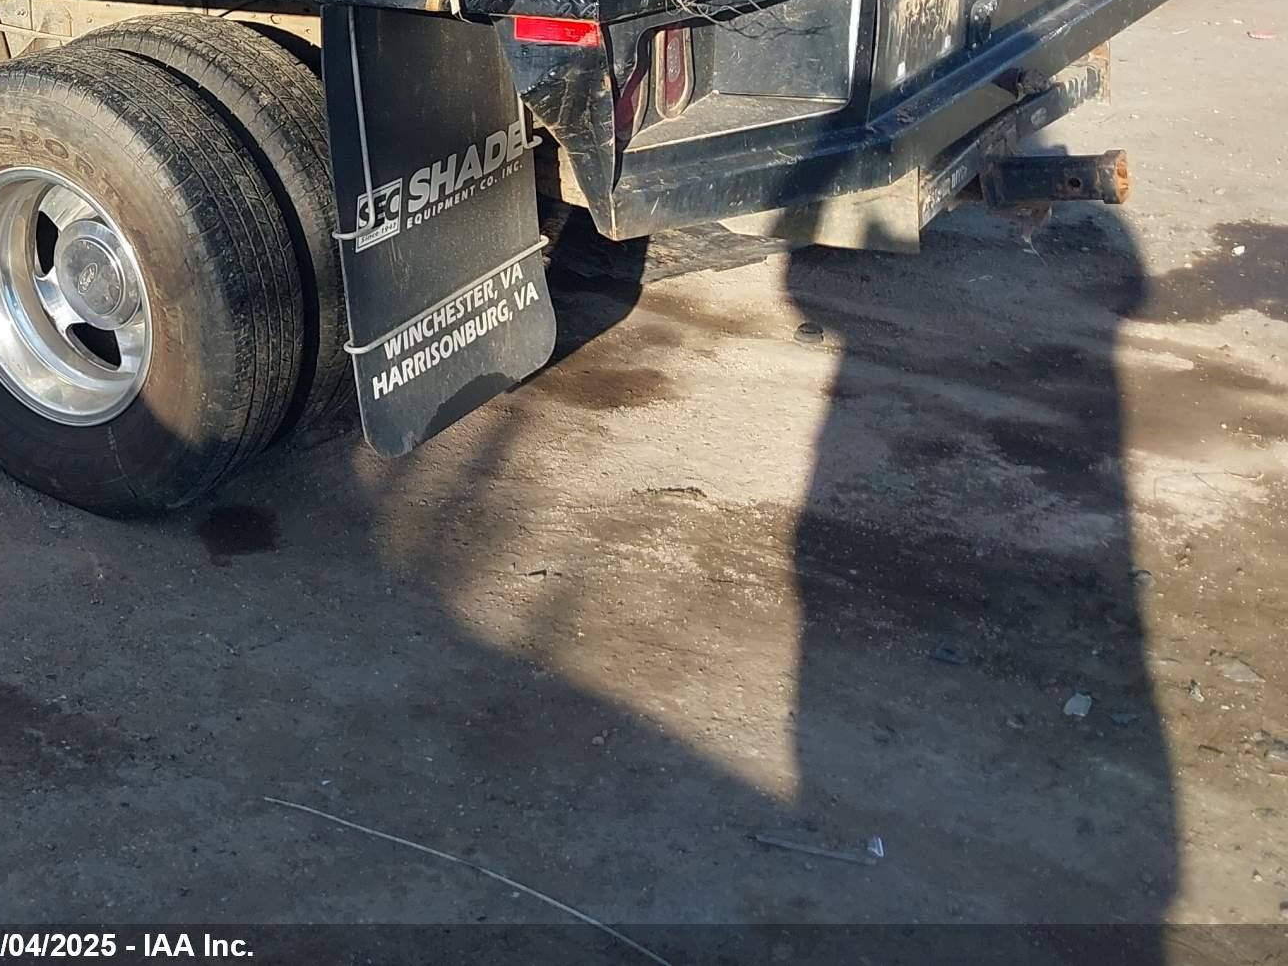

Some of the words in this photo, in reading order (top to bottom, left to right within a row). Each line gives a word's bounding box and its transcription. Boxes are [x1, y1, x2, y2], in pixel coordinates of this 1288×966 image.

[406, 185, 476, 229] EQUIPMENT
[479, 174, 499, 191] CO.
[502, 162, 523, 180] INC.
[407, 119, 526, 213] SHADE
[371, 298, 514, 400] HARRISONBURG,
[515, 281, 540, 313] VA
[383, 278, 499, 360] WINCHESTER,
[500, 263, 524, 290] VA
